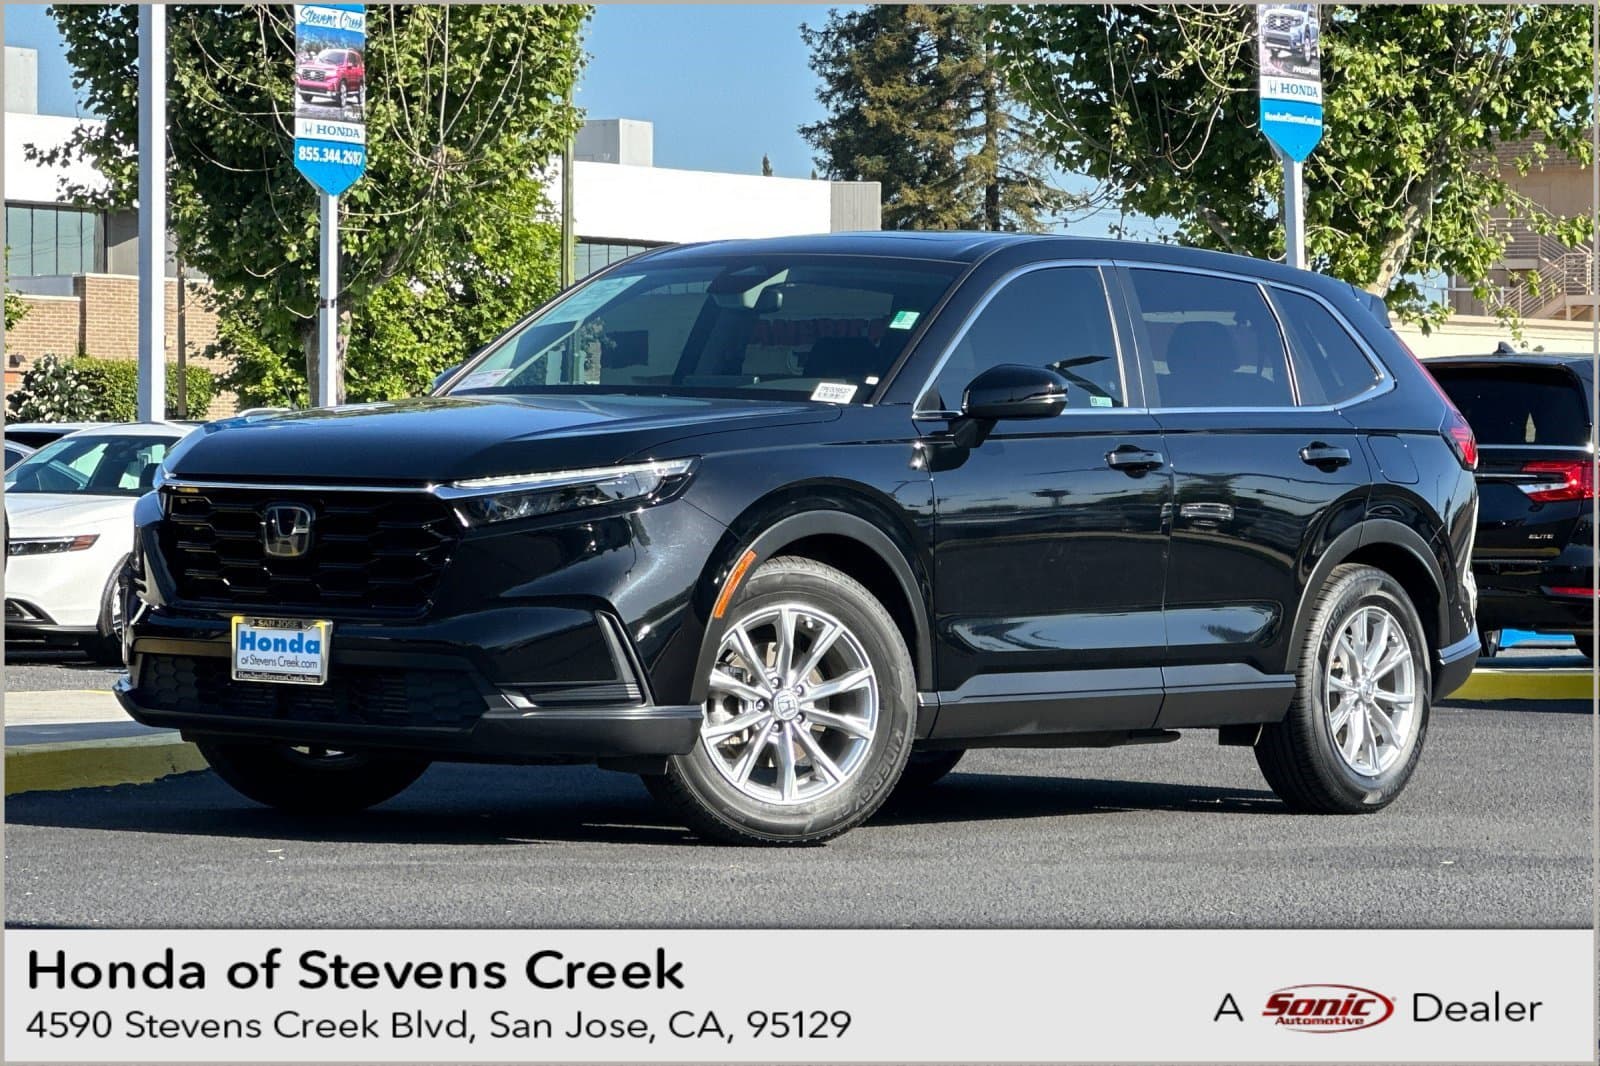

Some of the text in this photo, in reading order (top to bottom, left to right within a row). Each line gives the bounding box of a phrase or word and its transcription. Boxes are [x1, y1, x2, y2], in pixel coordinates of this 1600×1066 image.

[299, 6, 363, 31] Stevens Creek
[1280, 82, 1319, 98] HONDA
[316, 124, 361, 139] HONDA
[258, 619, 299, 629] SAN JOSE
[240, 630, 321, 654] Honda
[241, 656, 249, 665] of
[249, 654, 277, 667] Stevens
